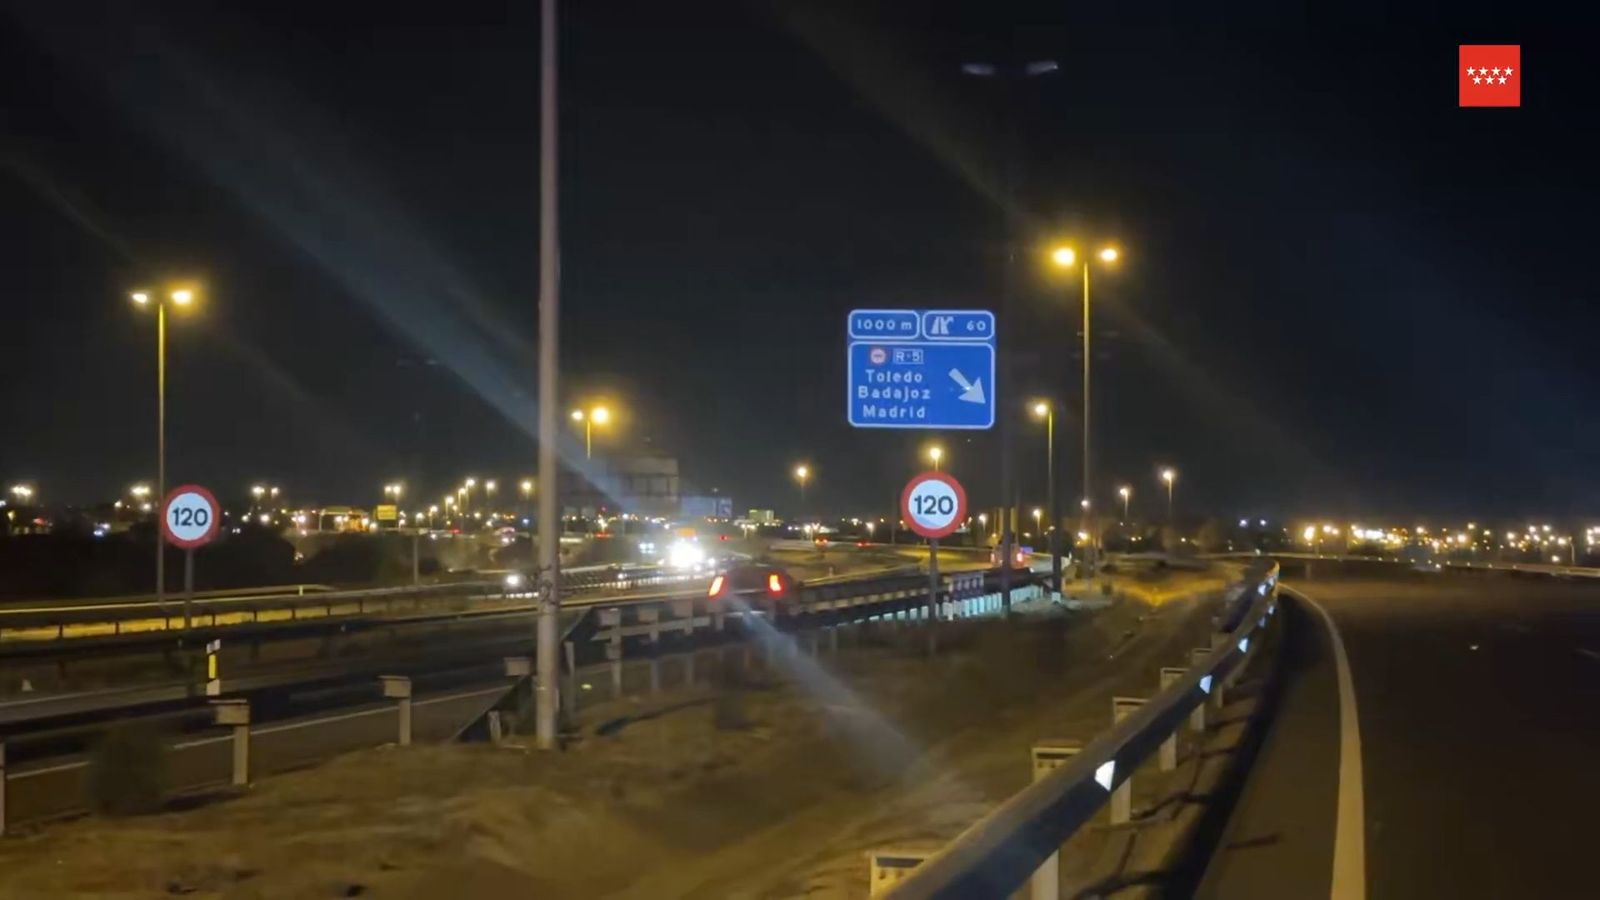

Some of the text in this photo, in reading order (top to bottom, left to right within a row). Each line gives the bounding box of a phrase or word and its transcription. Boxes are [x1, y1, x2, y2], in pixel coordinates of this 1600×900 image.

[857, 319, 912, 330] 1000 m
[966, 320, 986, 331] 60
[865, 369, 923, 383] Toledo
[858, 385, 931, 403] Badajoz
[863, 404, 926, 419] Madrid
[914, 495, 954, 515] 120
[172, 507, 208, 527] 120
